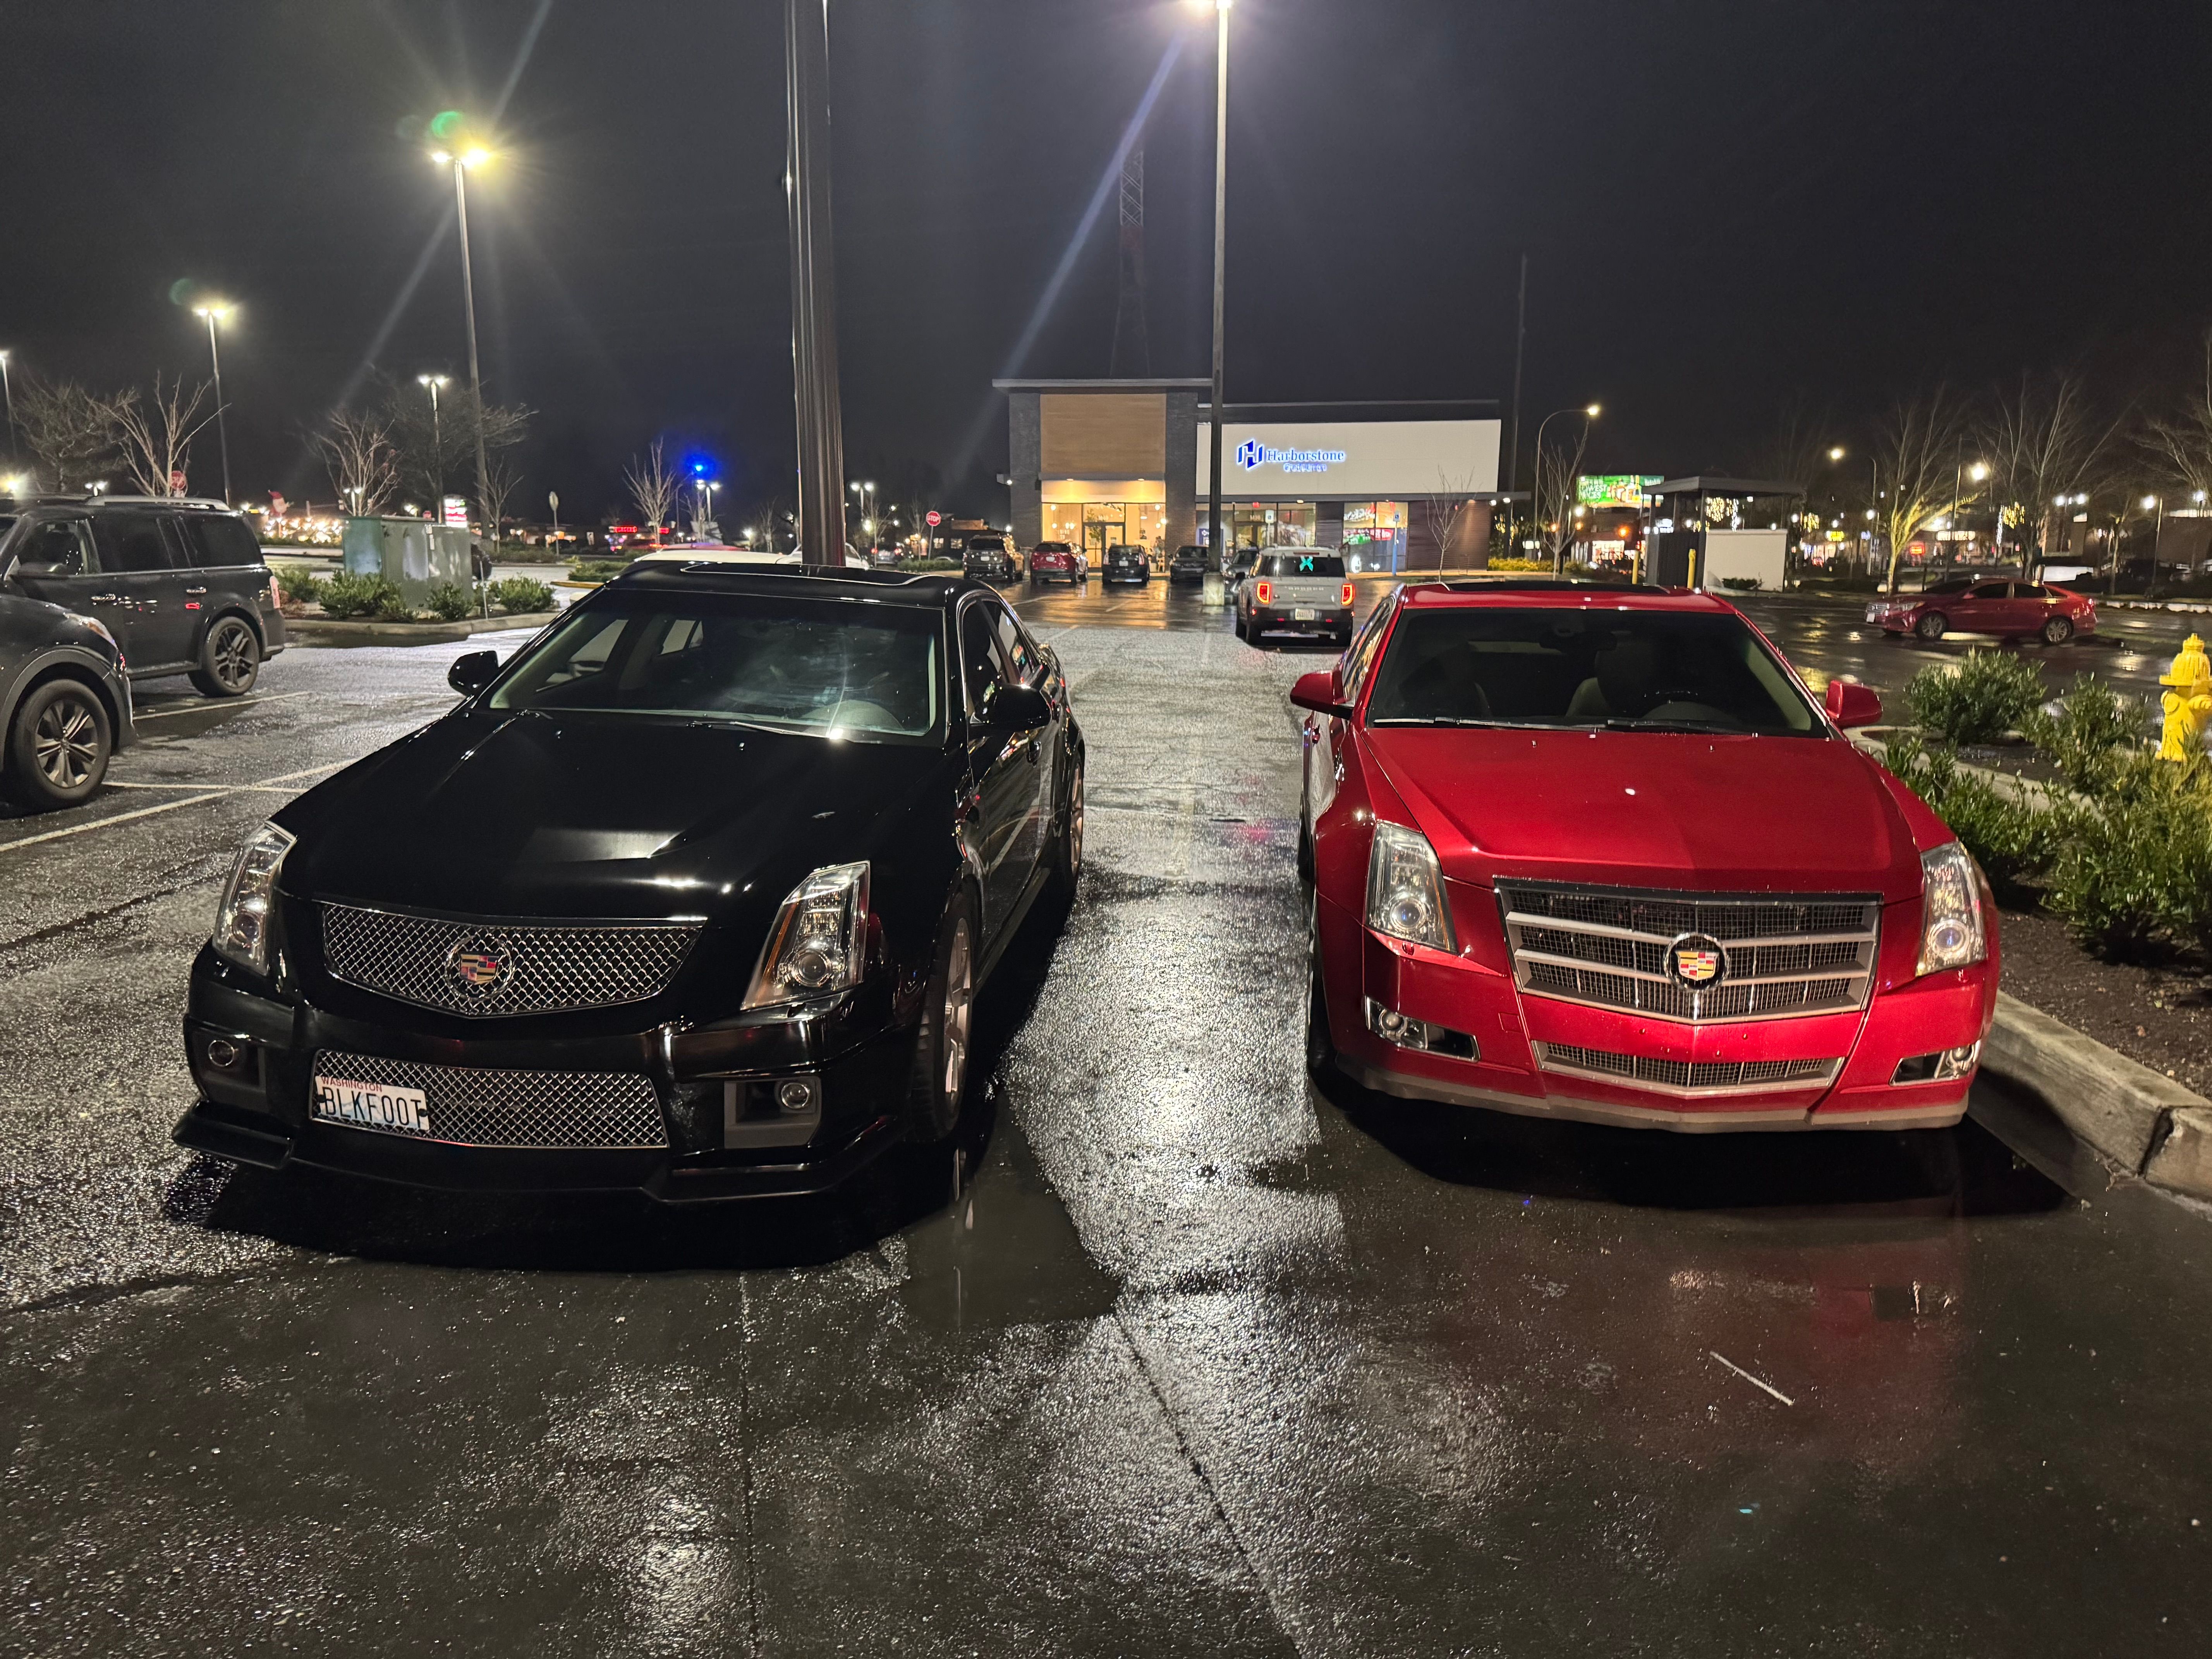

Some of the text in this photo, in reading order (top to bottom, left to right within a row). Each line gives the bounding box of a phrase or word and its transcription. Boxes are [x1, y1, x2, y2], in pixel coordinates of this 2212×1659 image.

[1267, 449, 1345, 462] Harborstone
[321, 1077, 383, 1092] WASHINGTON
[323, 1087, 421, 1128] BLKFOOT
